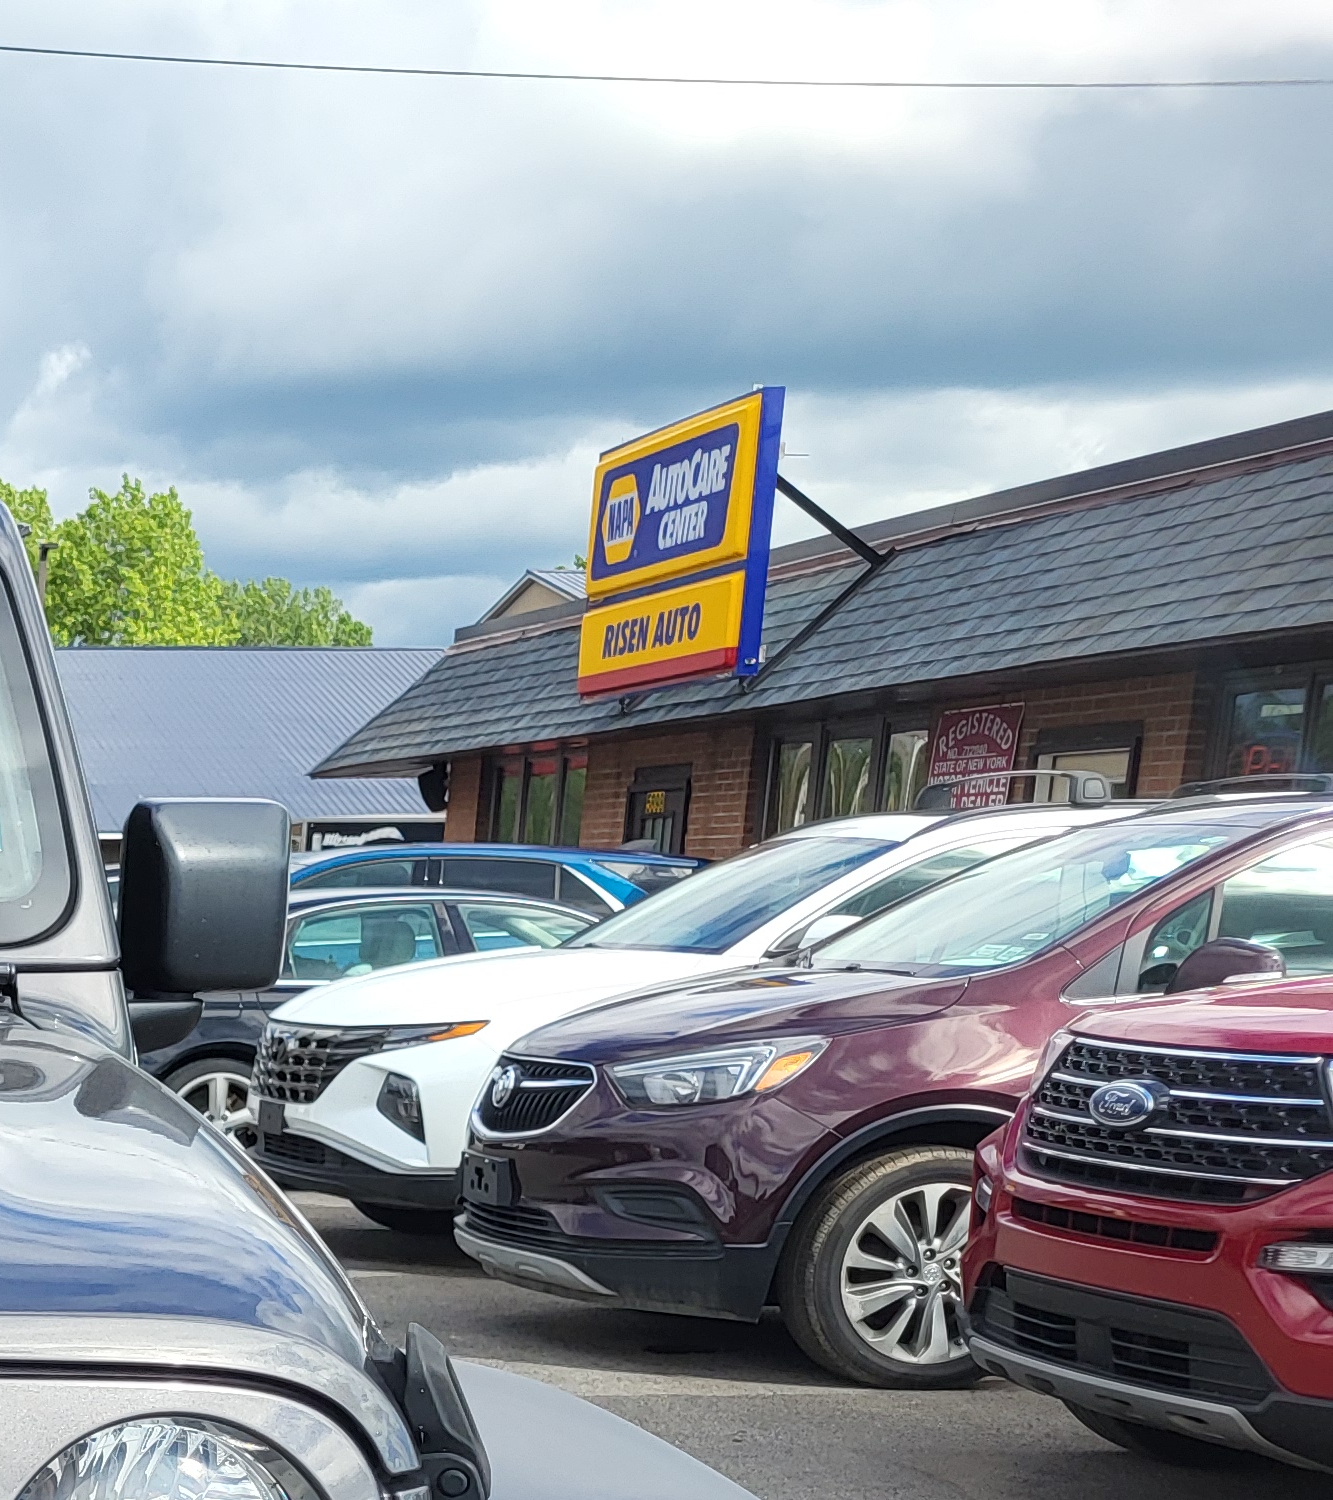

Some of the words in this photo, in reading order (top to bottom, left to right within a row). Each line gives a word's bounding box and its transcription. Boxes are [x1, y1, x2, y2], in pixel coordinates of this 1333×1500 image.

[607, 496, 635, 542] NAPA
[657, 500, 708, 550] CENTER
[601, 614, 651, 659] RISEN
[651, 602, 702, 649] AUTO
[938, 712, 1013, 757] REGISTERED
[933, 761, 956, 775] STATE
[956, 760, 968, 774] OF
[967, 758, 986, 771] NEW
[986, 756, 1009, 769] YORK
[1098, 1090, 1137, 1116] Ford
